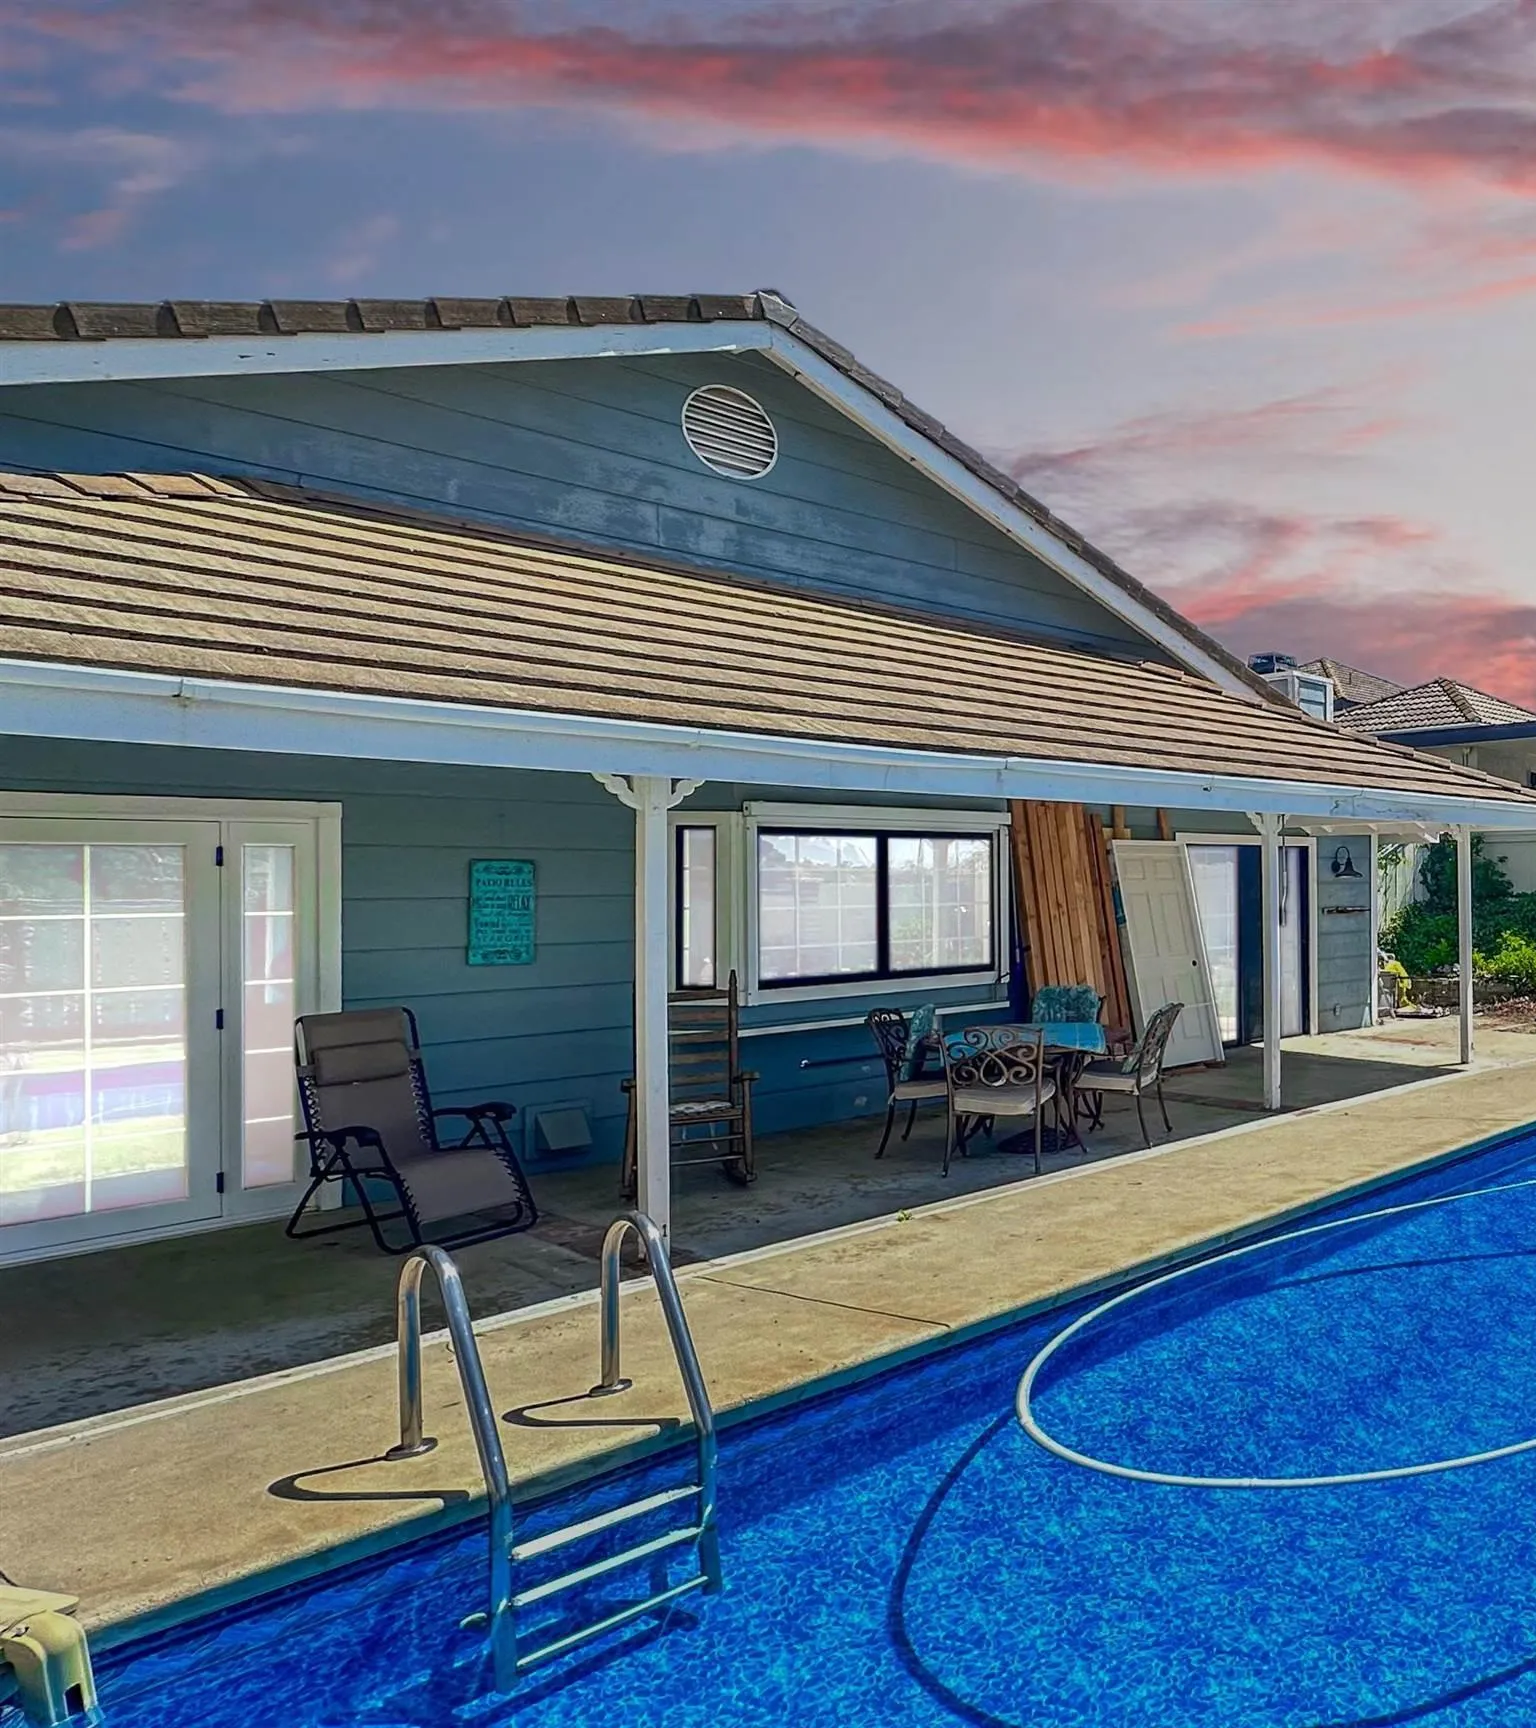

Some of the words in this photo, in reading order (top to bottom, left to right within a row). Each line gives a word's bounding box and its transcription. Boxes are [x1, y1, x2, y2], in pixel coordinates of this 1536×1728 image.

[476, 878, 502, 887] PATIO
[504, 878, 533, 887] RULES
[507, 895, 533, 911] RELAX
